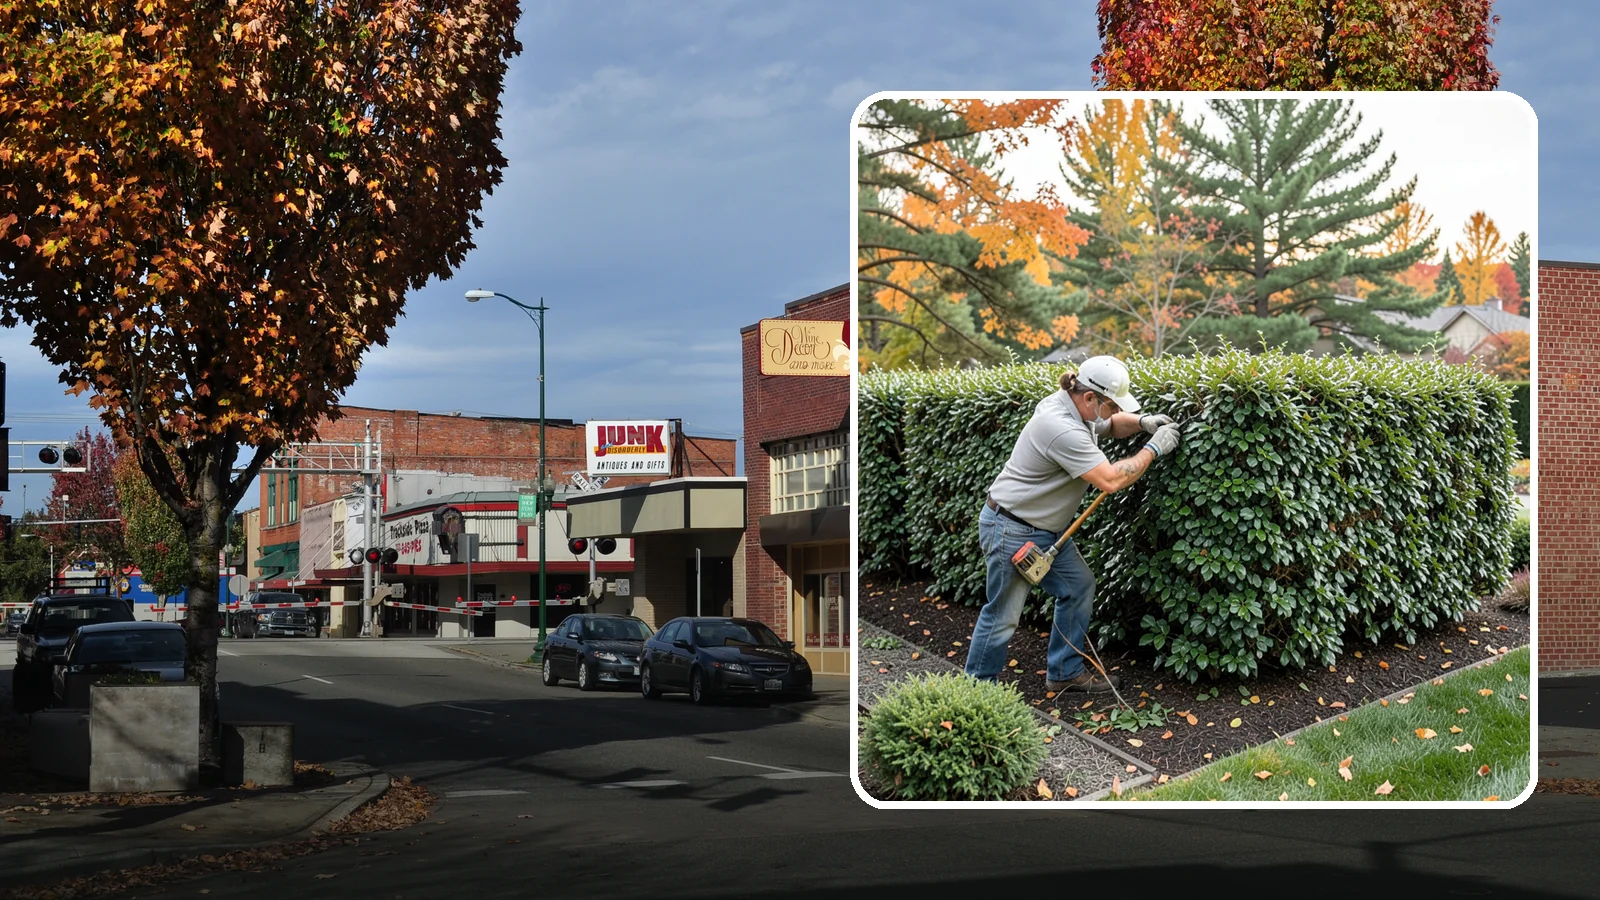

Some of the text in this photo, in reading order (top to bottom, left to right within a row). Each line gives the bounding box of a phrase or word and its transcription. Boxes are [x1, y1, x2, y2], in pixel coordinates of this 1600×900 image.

[596, 425, 664, 457] JUNK
[607, 446, 646, 454] DISORDERLY
[597, 460, 665, 470] ANTIQUES AND GIFTS
[414, 519, 429, 535] Pizza
